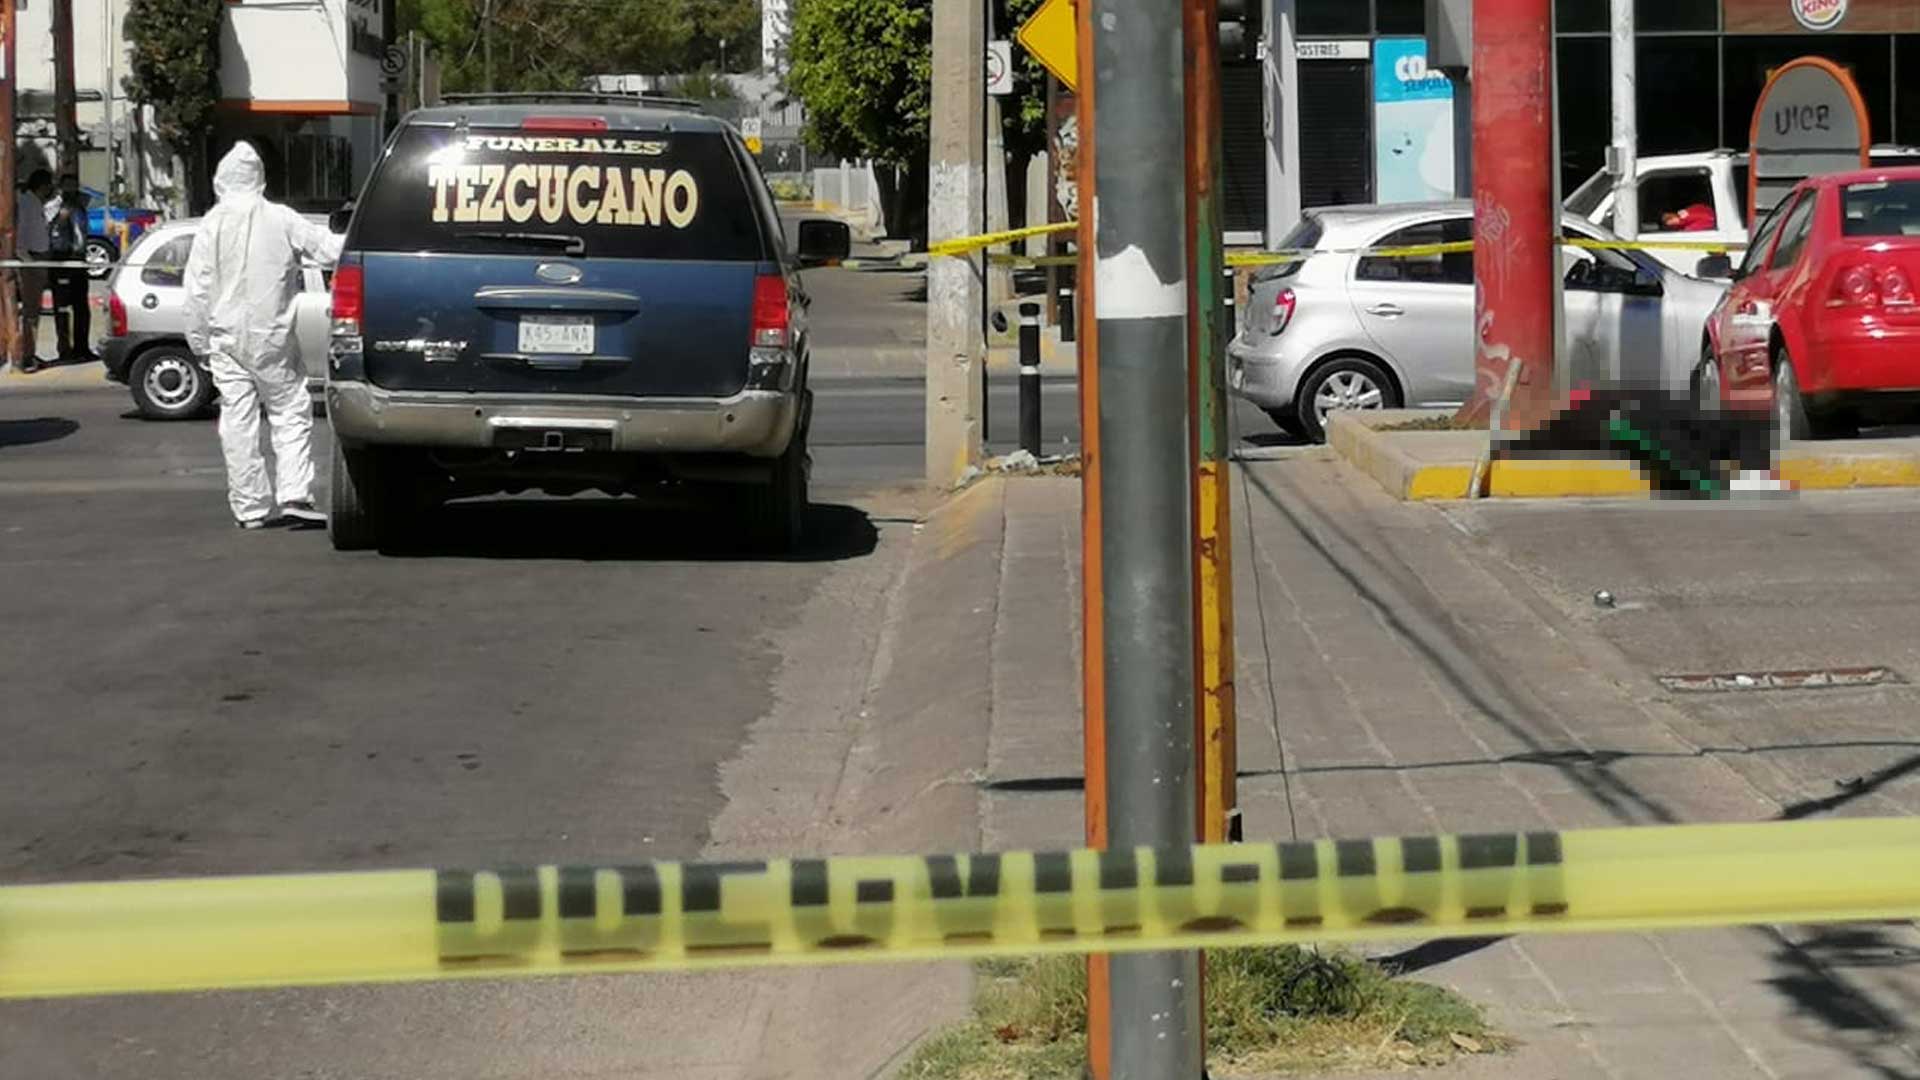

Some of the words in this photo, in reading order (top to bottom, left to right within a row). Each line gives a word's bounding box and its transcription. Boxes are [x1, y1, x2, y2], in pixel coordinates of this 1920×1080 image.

[1296, 44, 1341, 56] OSTRES
[462, 136, 666, 156] FUNERALES
[428, 163, 698, 228] TEZCUCANO
